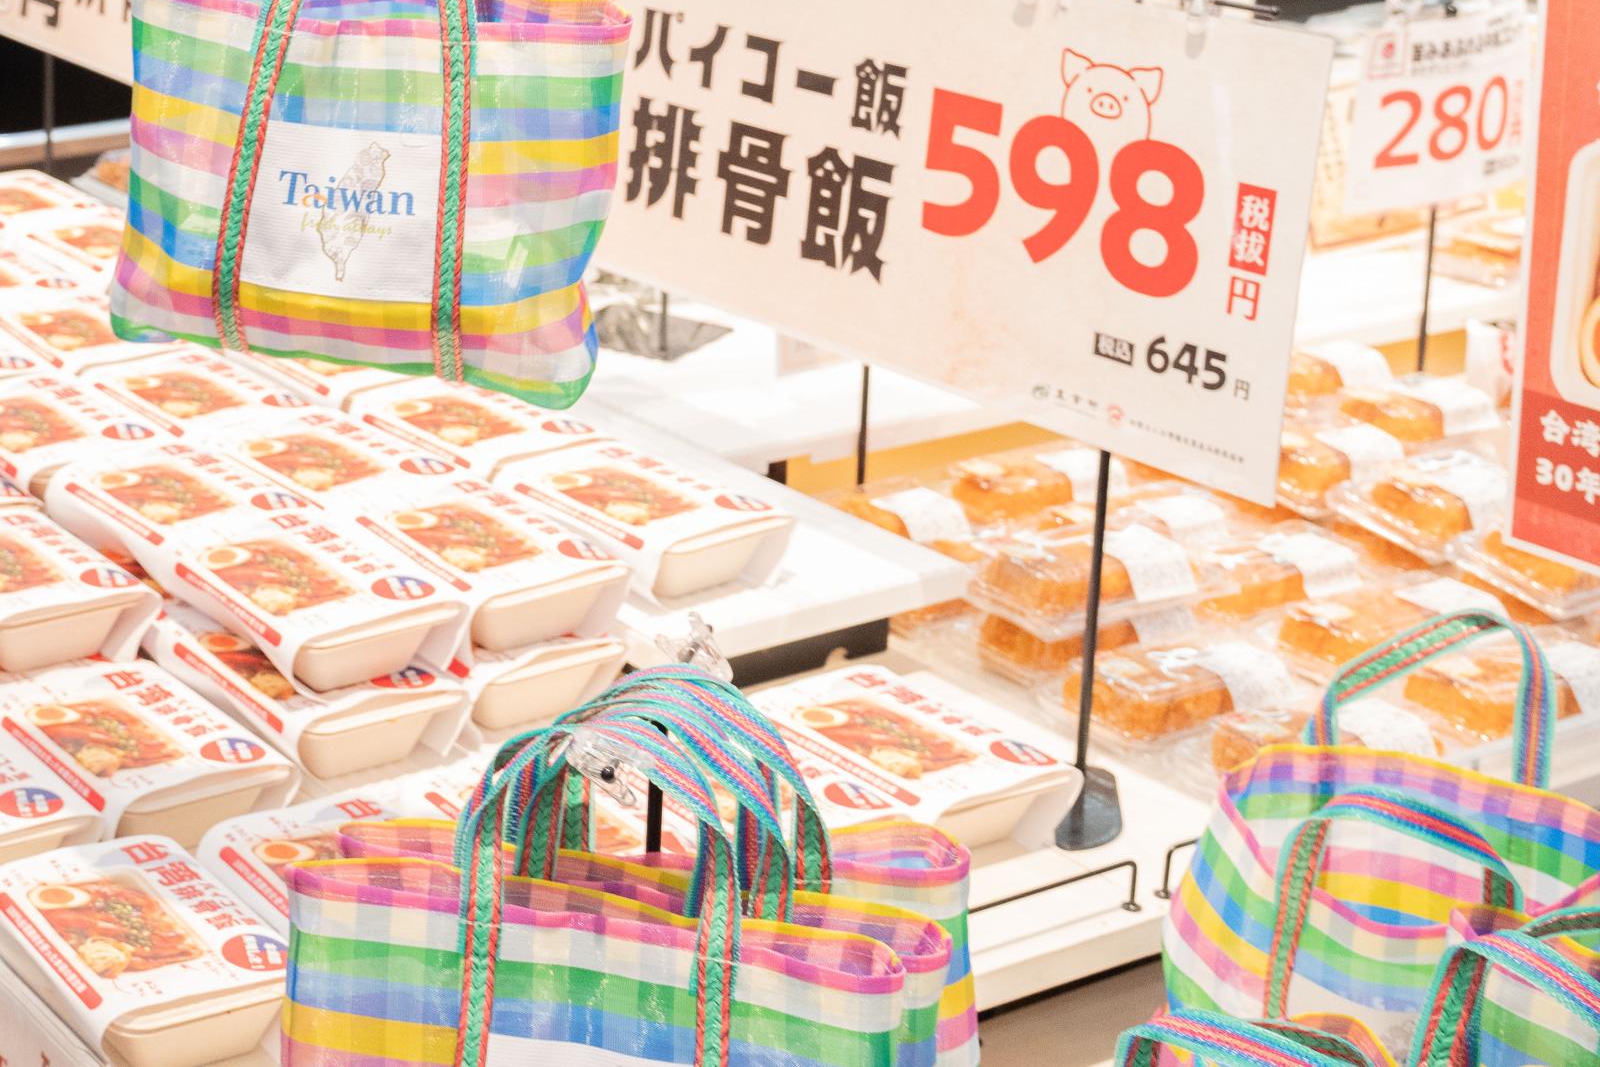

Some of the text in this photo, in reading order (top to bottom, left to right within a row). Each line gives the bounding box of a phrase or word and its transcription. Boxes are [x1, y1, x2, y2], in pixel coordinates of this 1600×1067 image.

[633, 7, 912, 141] パイコー飯
[1373, 74, 1509, 170] 280
[279, 170, 416, 216] Taiwan
[623, 95, 898, 284] 排骨飯
[920, 87, 1204, 299] 598
[1225, 191, 1274, 323] 税抜 円
[1146, 334, 1228, 391] 645
[120, 841, 204, 888] 台湾
